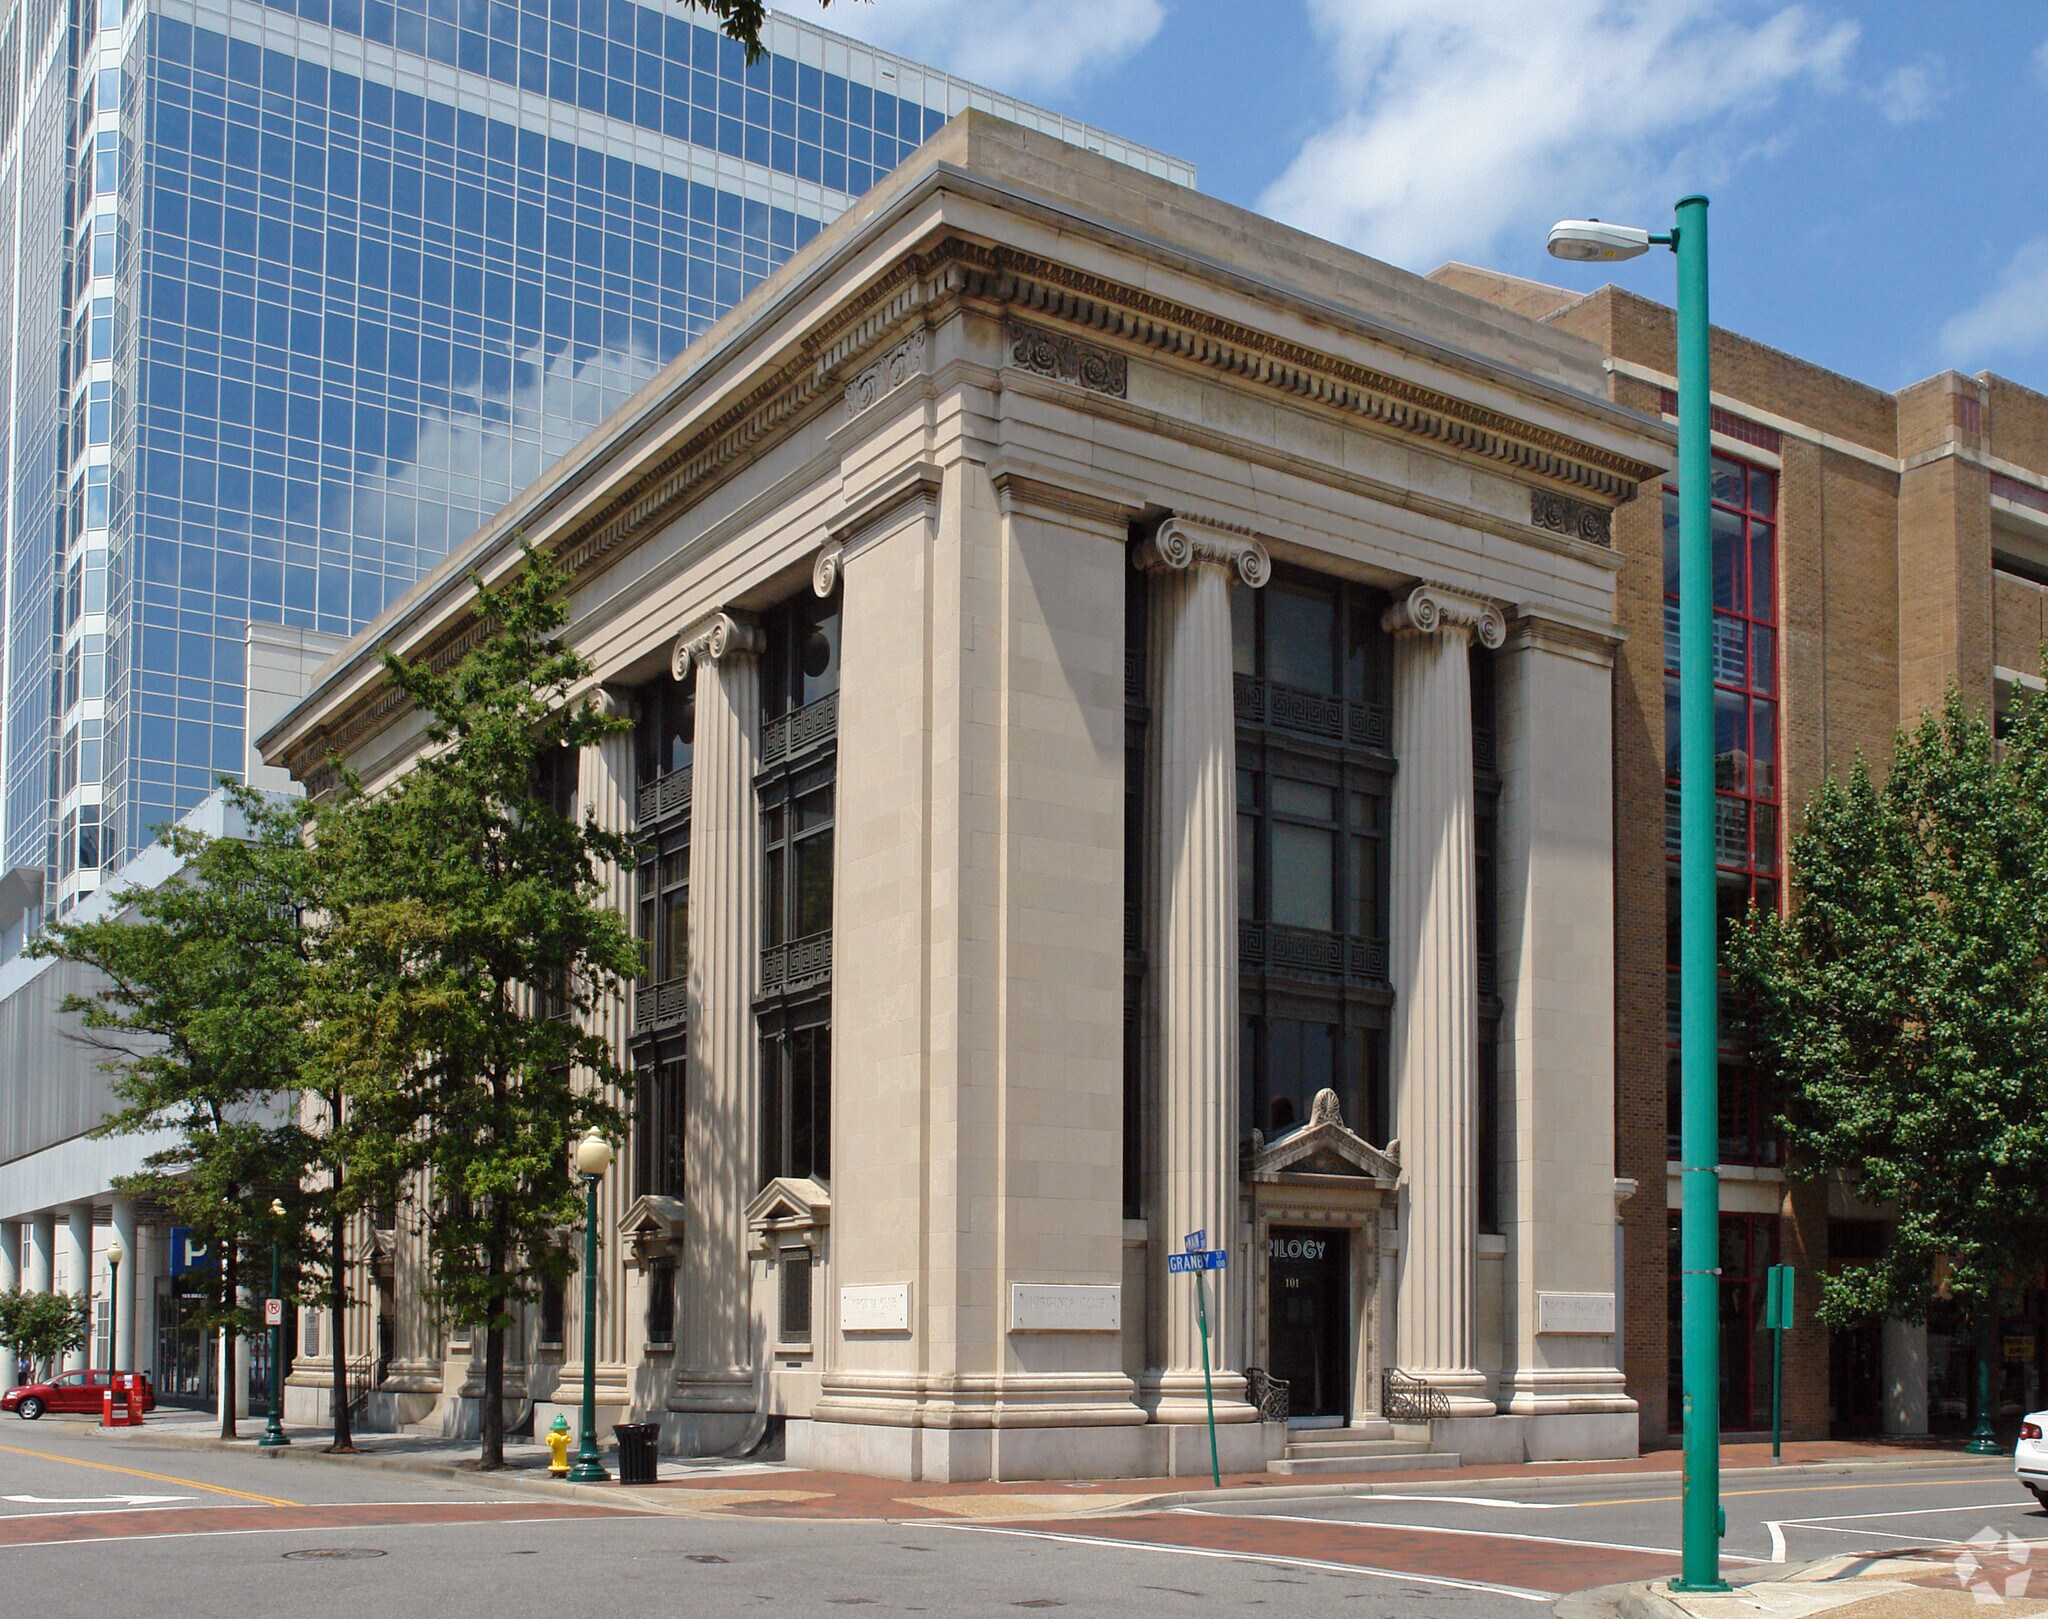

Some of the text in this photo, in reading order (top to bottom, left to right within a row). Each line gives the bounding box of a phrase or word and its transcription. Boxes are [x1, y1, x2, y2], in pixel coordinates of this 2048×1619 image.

[1170, 1251, 1222, 1271] GRANBY ST
[1285, 1278, 1300, 1288] 101
